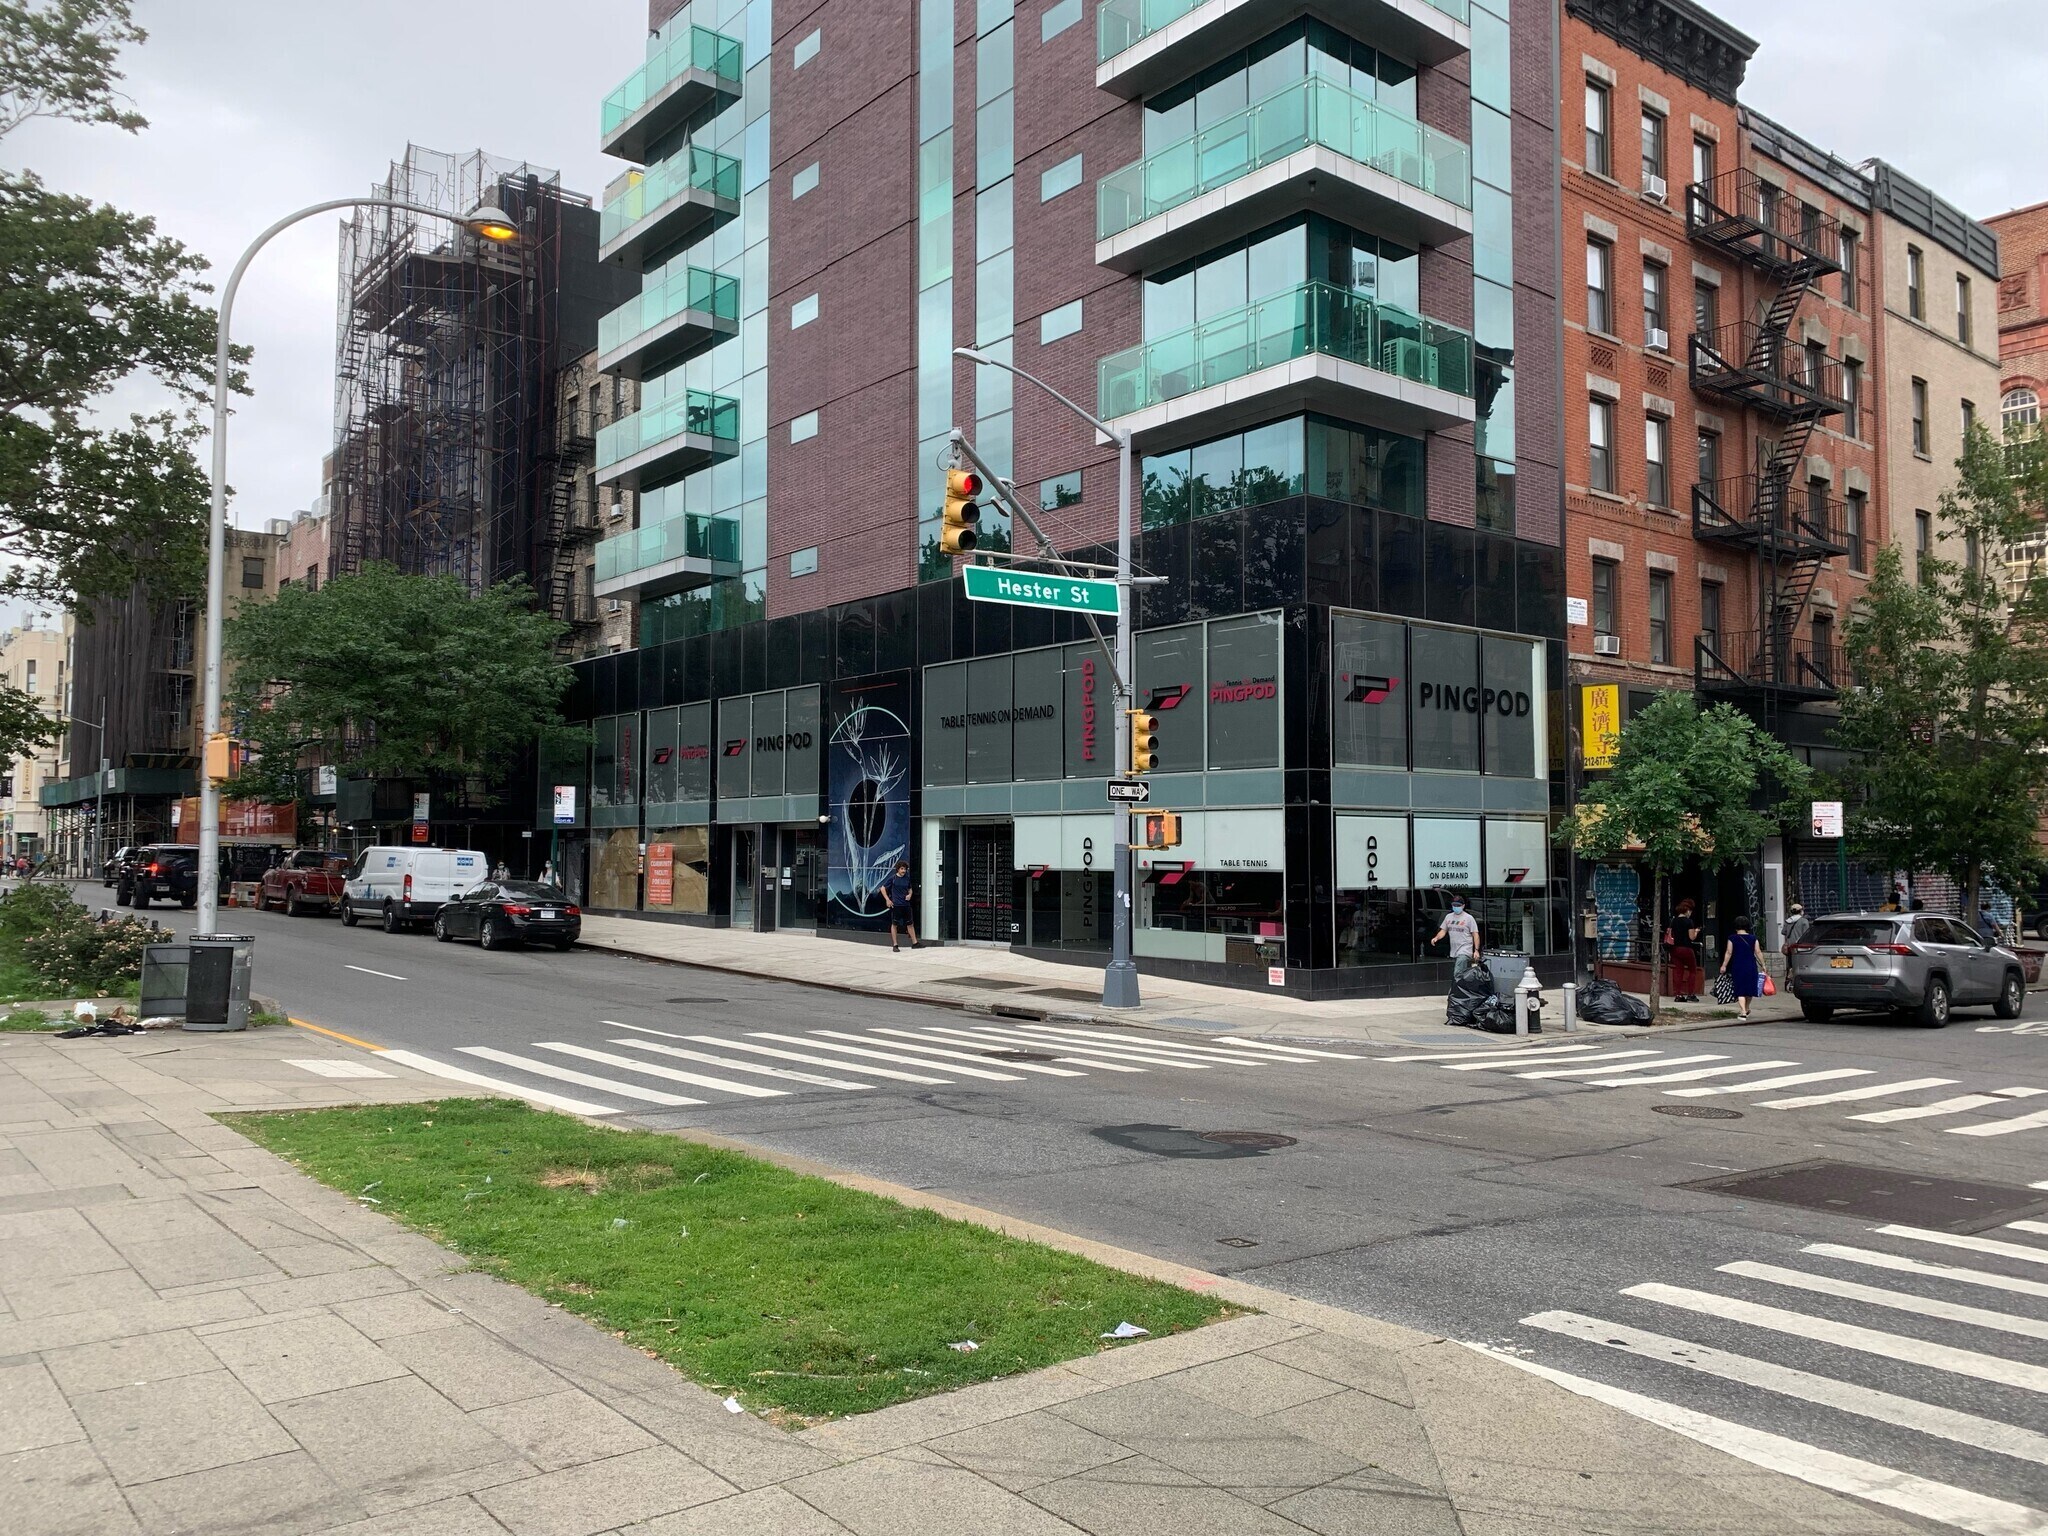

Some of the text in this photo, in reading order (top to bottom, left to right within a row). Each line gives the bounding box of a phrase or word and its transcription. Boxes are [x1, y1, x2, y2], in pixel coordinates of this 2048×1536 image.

[997, 577, 1089, 604] Hester St
[1252, 675, 1276, 684] Demand
[1209, 683, 1276, 704] PINGPOD
[1420, 682, 1531, 718] PINGPOD
[941, 704, 1054, 729] TABLE TENNIS ON DEMAND
[1081, 658, 1096, 761] PINGPOD
[756, 732, 812, 752] PINGPOD
[1584, 755, 1616, 767] 212-677-7
[1111, 786, 1144, 796] ONE WAY
[1219, 859, 1240, 867] TABLE
[1083, 837, 1093, 927] PINGPOD
